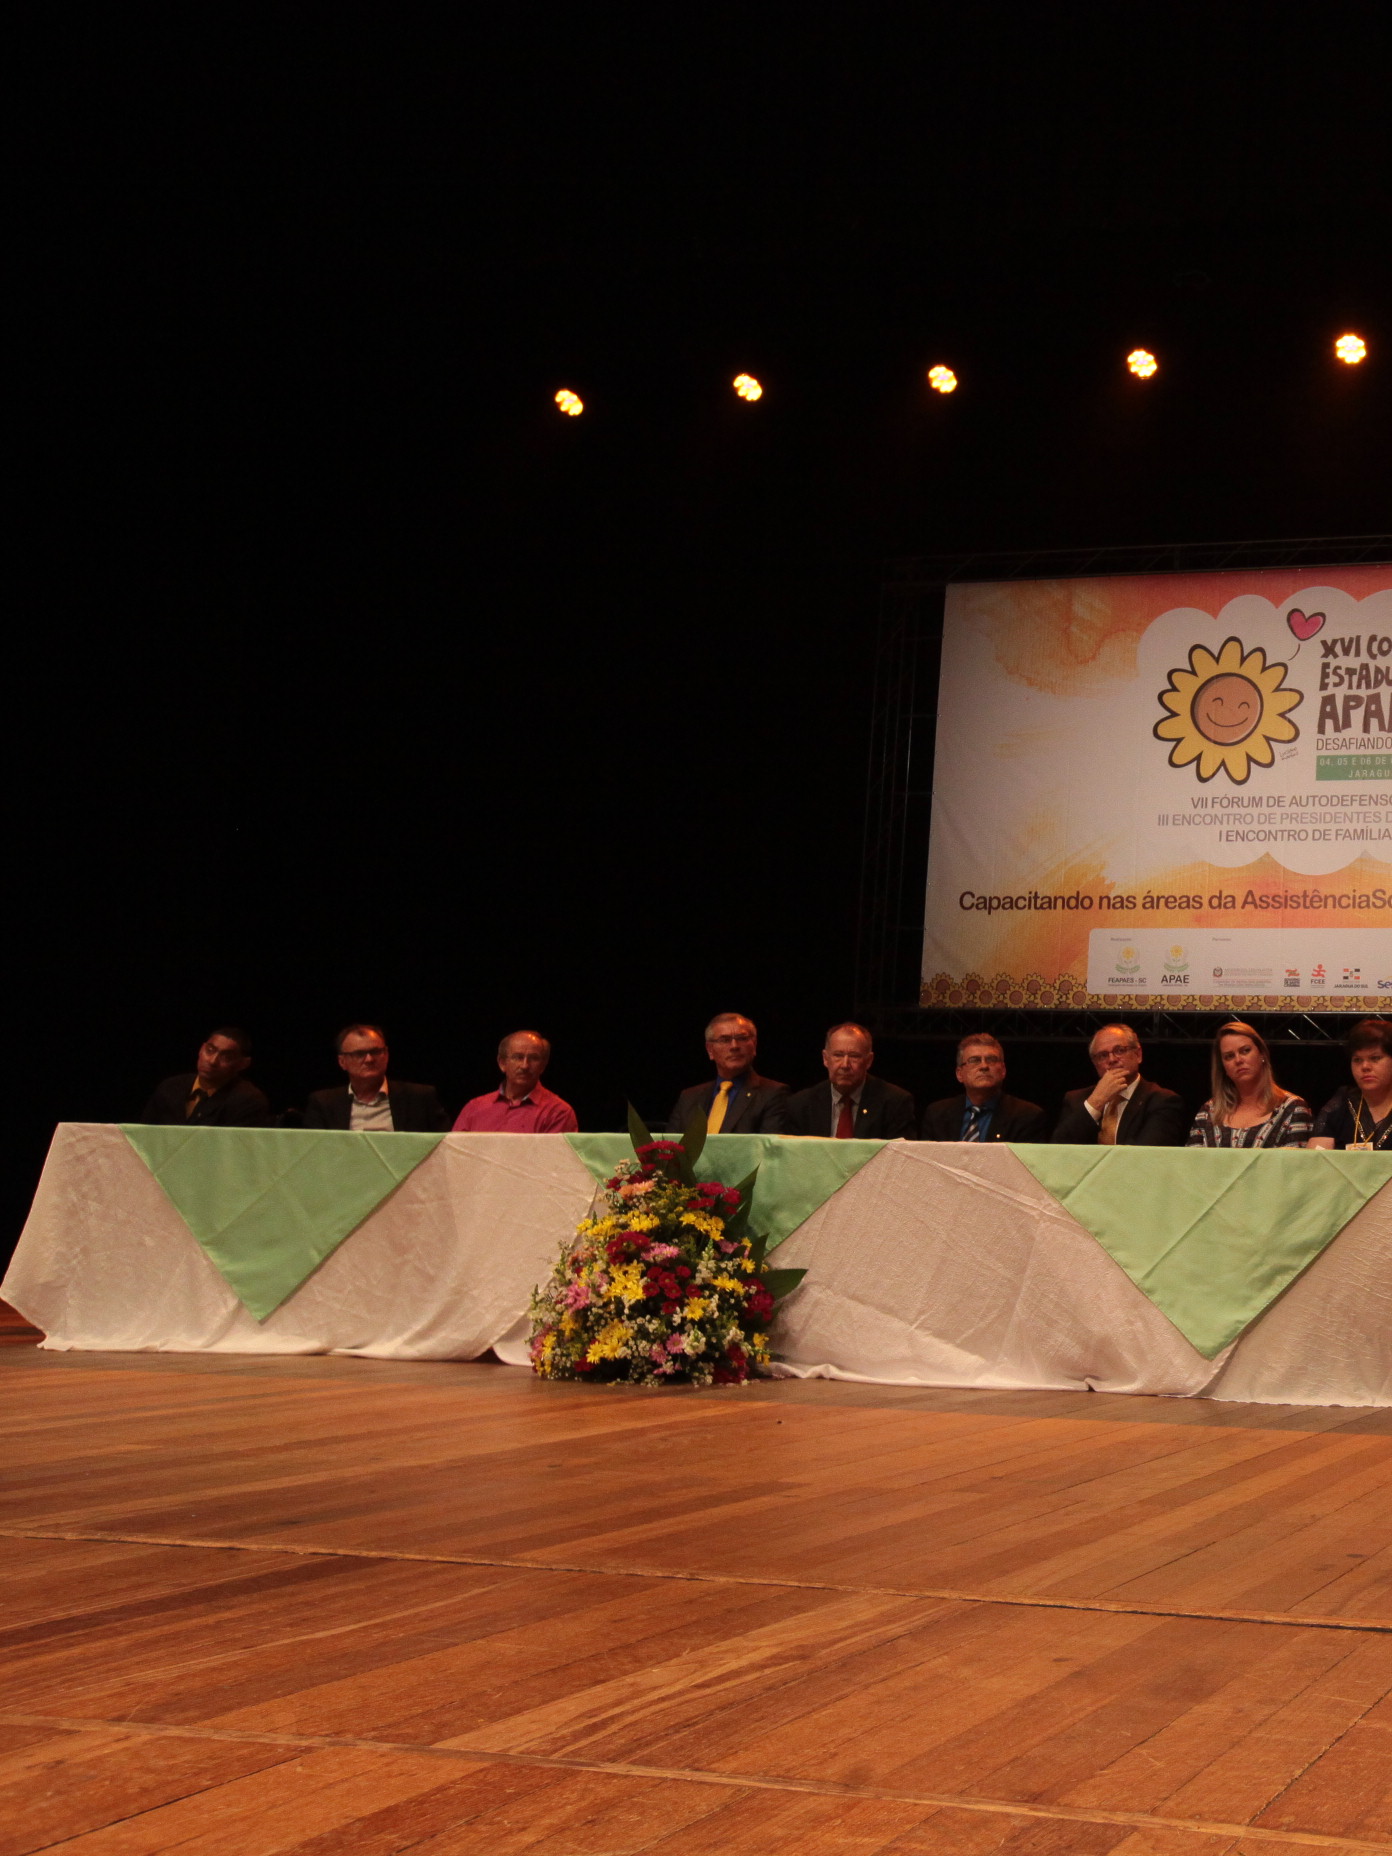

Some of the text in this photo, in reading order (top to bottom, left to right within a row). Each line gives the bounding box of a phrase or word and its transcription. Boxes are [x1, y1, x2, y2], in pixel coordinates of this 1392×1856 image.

[1320, 635, 1361, 660] XVI
[1316, 737, 1392, 751] DESAFIANDO
[1360, 757, 1371, 765] 06
[1191, 797, 1208, 809] VII
[1211, 794, 1263, 809] FÓRUM
[1267, 796, 1286, 808] DE
[1157, 814, 1168, 827] III
[1172, 813, 1254, 826] ENCONTRO
[1258, 812, 1278, 825] DE
[1280, 812, 1382, 825] PRESIDENTES
[1218, 830, 1223, 842] I
[1226, 829, 1308, 842] ENCONTRO
[1312, 829, 1332, 841] DE
[959, 890, 1096, 916] Capacitando
[1098, 894, 1138, 911] nas
[1142, 890, 1204, 912] áreas
[1208, 890, 1237, 911] da
[1161, 975, 1190, 983] APAE
